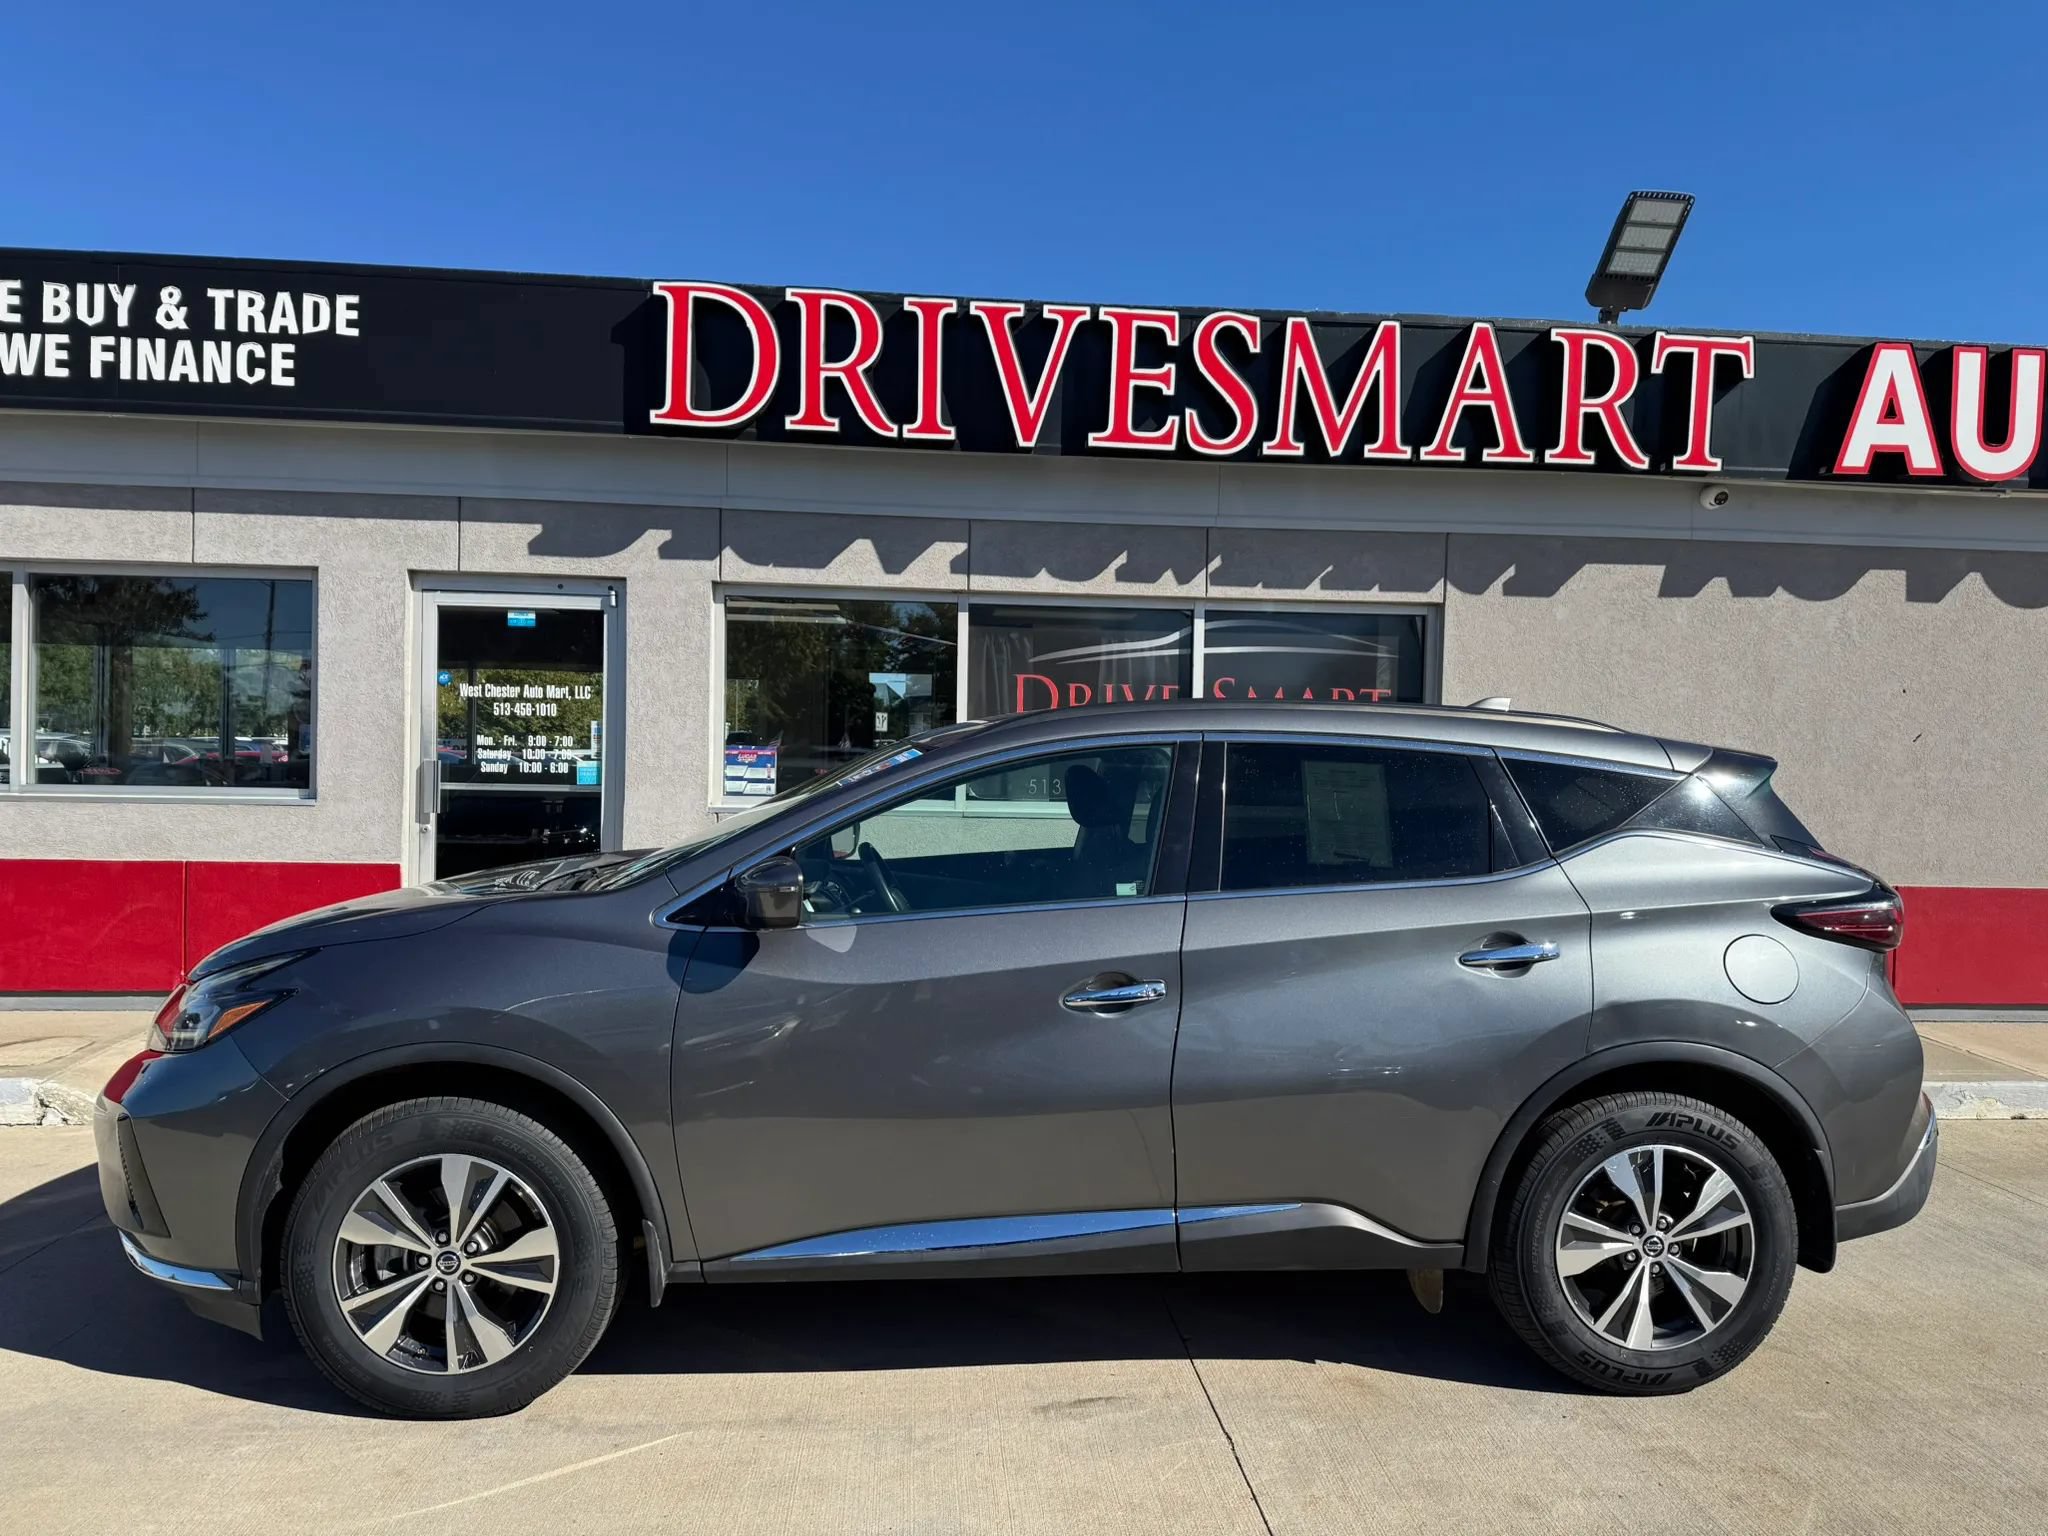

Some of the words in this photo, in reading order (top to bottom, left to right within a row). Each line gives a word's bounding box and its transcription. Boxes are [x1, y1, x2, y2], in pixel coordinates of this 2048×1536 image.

[42, 281, 136, 327] BUY
[155, 285, 189, 330] &
[207, 287, 360, 336] TRADE
[0, 331, 70, 377] WE
[90, 335, 295, 387] FINANCE
[650, 281, 1755, 472] DRIVESMART
[459, 682, 482, 698] West
[484, 683, 520, 699] Chester
[523, 684, 543, 699] Auto
[546, 685, 571, 701] Mart,
[574, 686, 591, 700] LLC
[476, 734, 496, 746] Mon.
[503, 735, 518, 747] Fri.
[527, 736, 547, 747] 9:00
[554, 736, 574, 747] 7:00
[477, 748, 512, 761] Saturday
[522, 749, 546, 760] 10:00
[480, 761, 509, 775] Sunday
[519, 761, 543, 774] 10:00
[1028, 778, 1062, 795] 513
